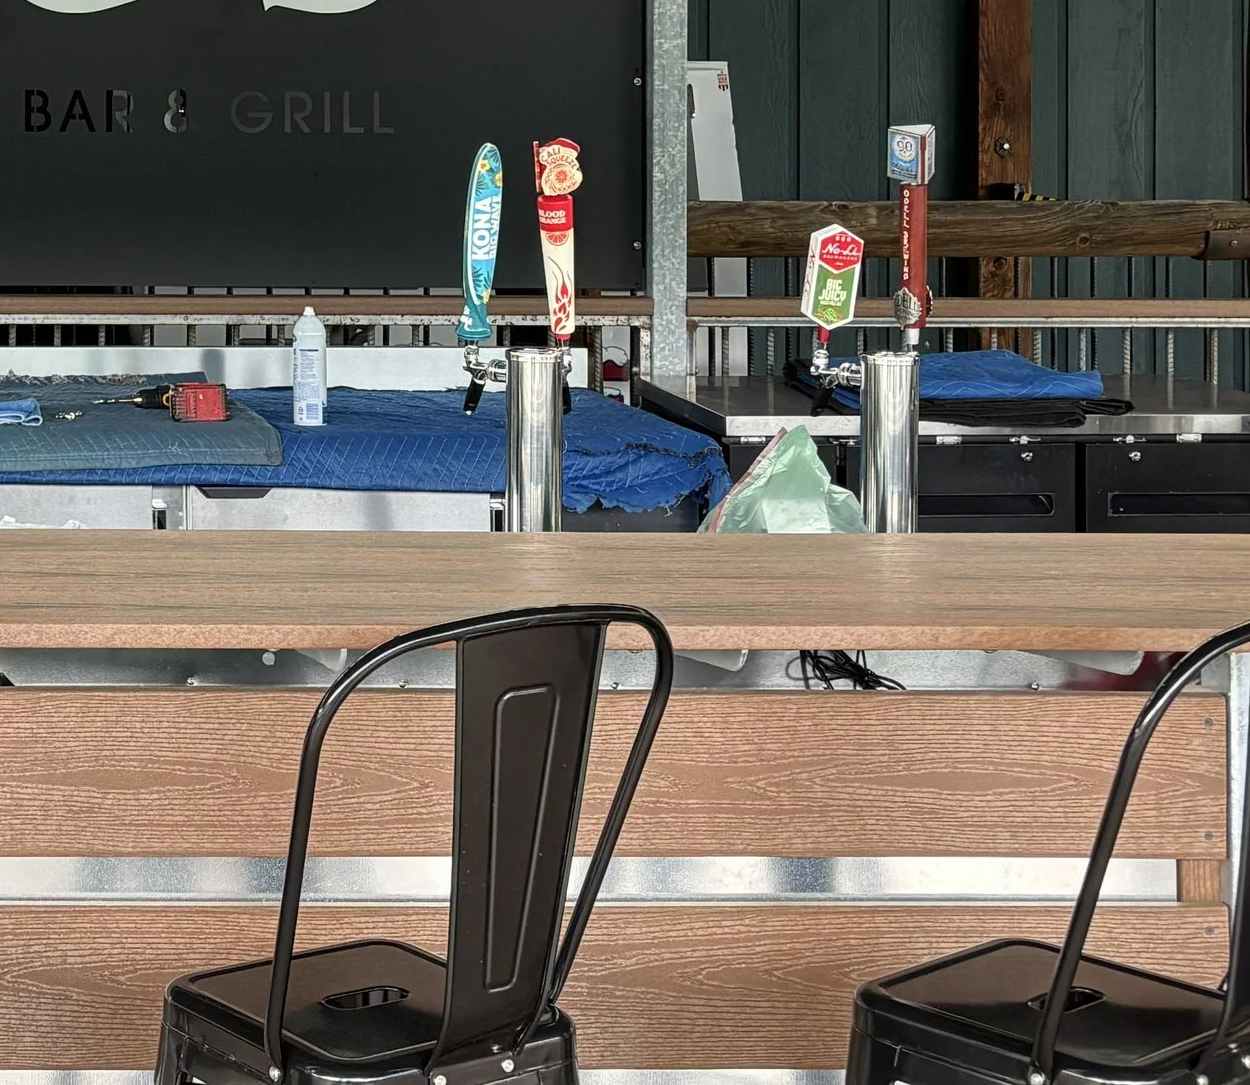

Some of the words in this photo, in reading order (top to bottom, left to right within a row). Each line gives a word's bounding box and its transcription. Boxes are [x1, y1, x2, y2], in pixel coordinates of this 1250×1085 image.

[24, 88, 134, 133] BAR
[162, 88, 194, 134] &
[230, 90, 394, 134] GRILL
[541, 147, 561, 163] CALI
[538, 209, 566, 218] BLOOD
[471, 196, 492, 261] KONA
[818, 289, 848, 302] JUICY
